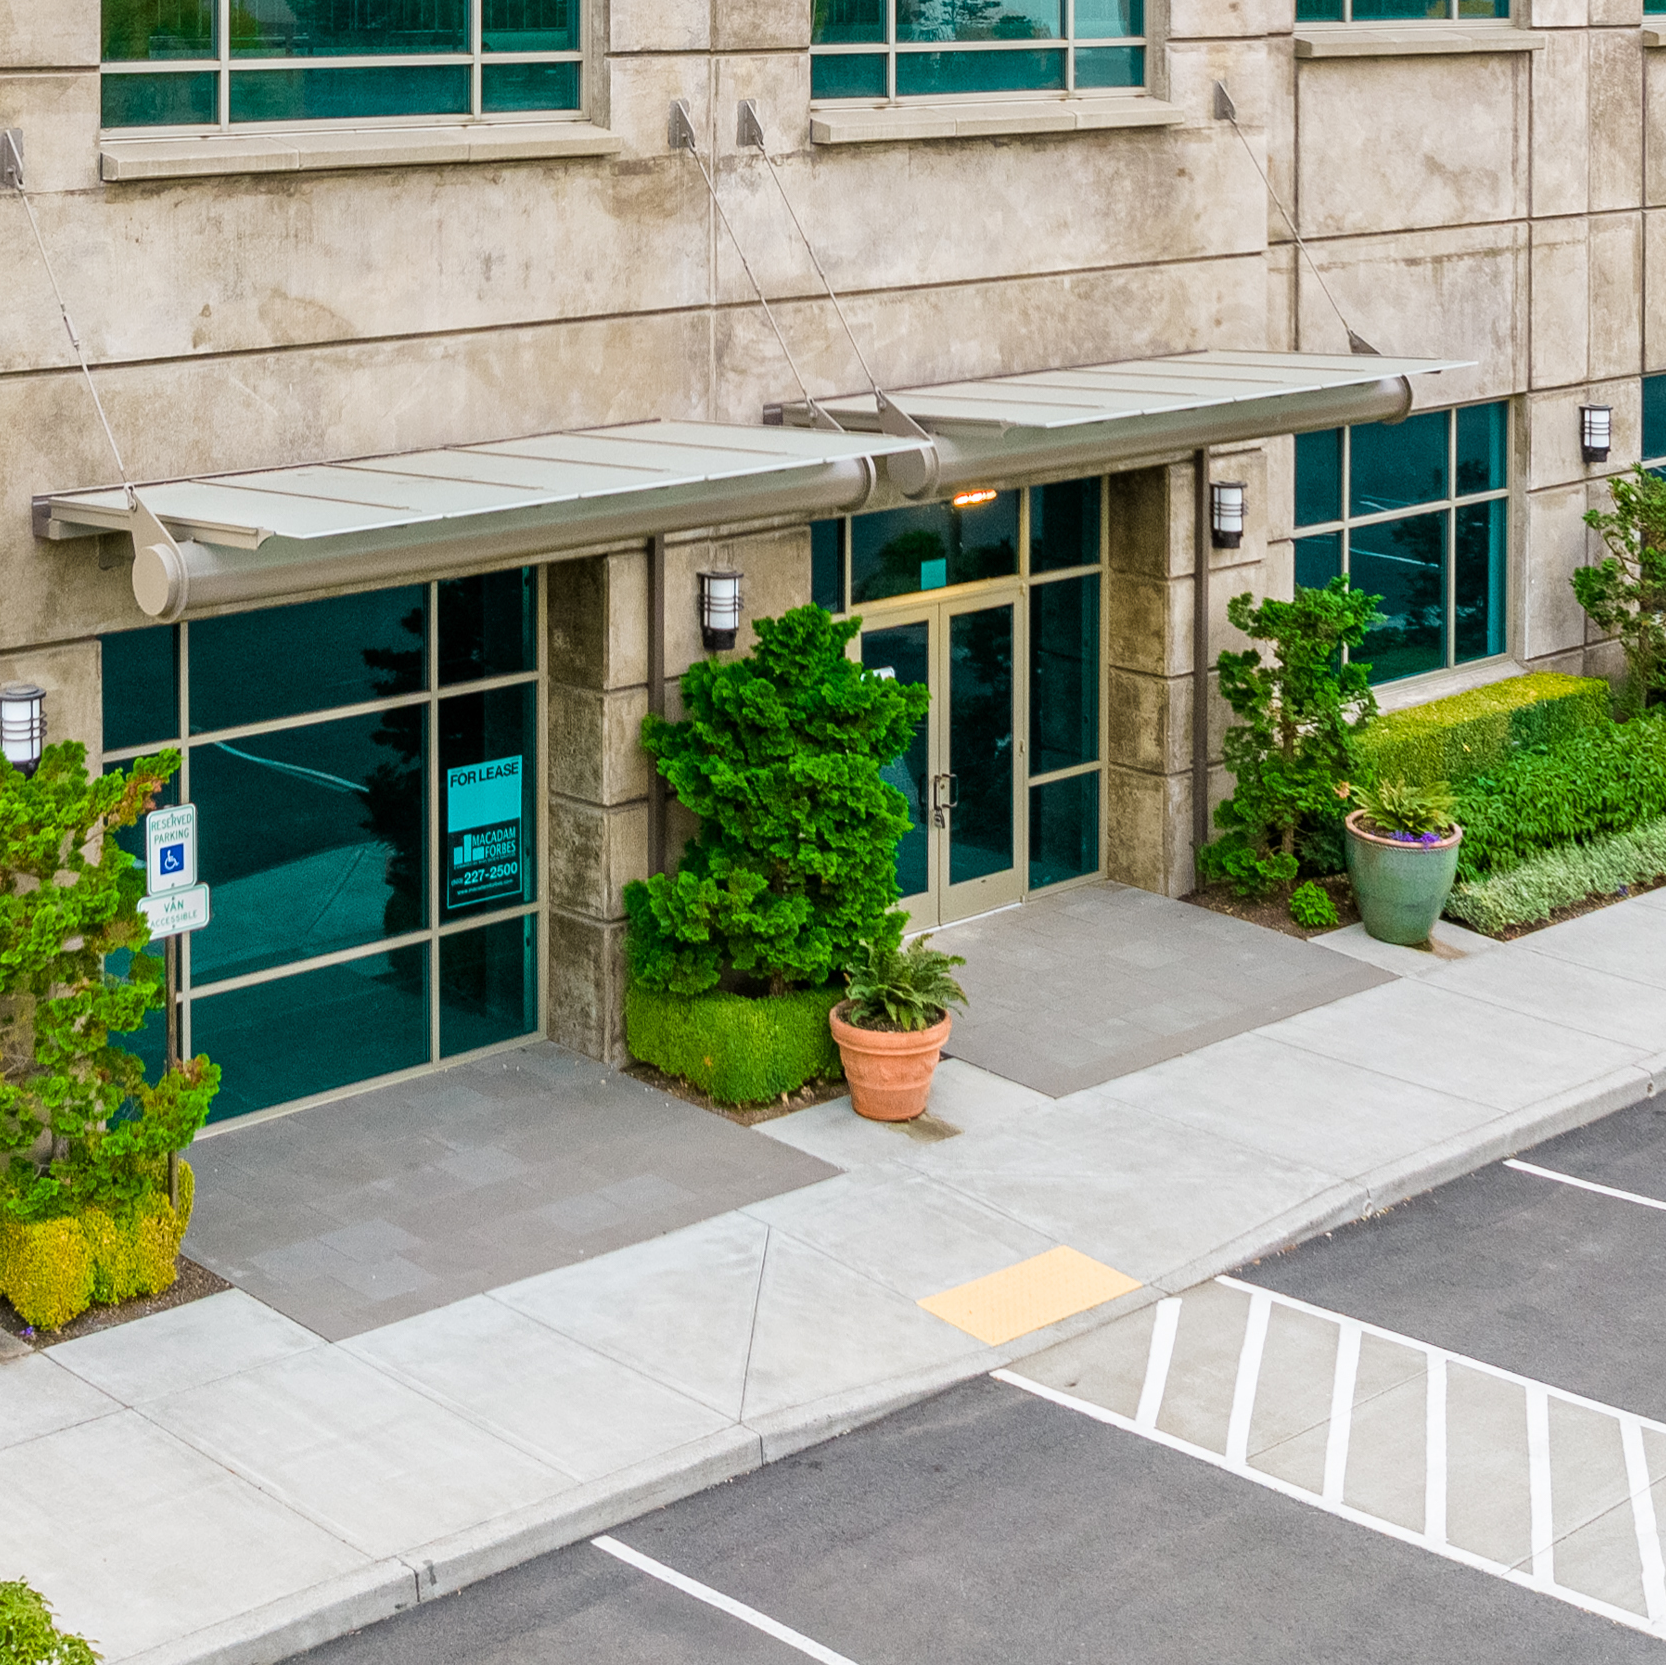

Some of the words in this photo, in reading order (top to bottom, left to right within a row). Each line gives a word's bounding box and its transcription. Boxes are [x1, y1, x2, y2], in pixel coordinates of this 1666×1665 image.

[450, 771, 477, 788] FOR
[479, 761, 519, 782] LEASE
[151, 813, 192, 831] RESERVED
[154, 827, 190, 844] PARKING
[472, 826, 516, 847] MACADAM
[485, 839, 516, 858] FORBES
[464, 861, 518, 886] 227-2500
[163, 899, 184, 913] VAN
[150, 909, 198, 929] ACCESSIBLE
